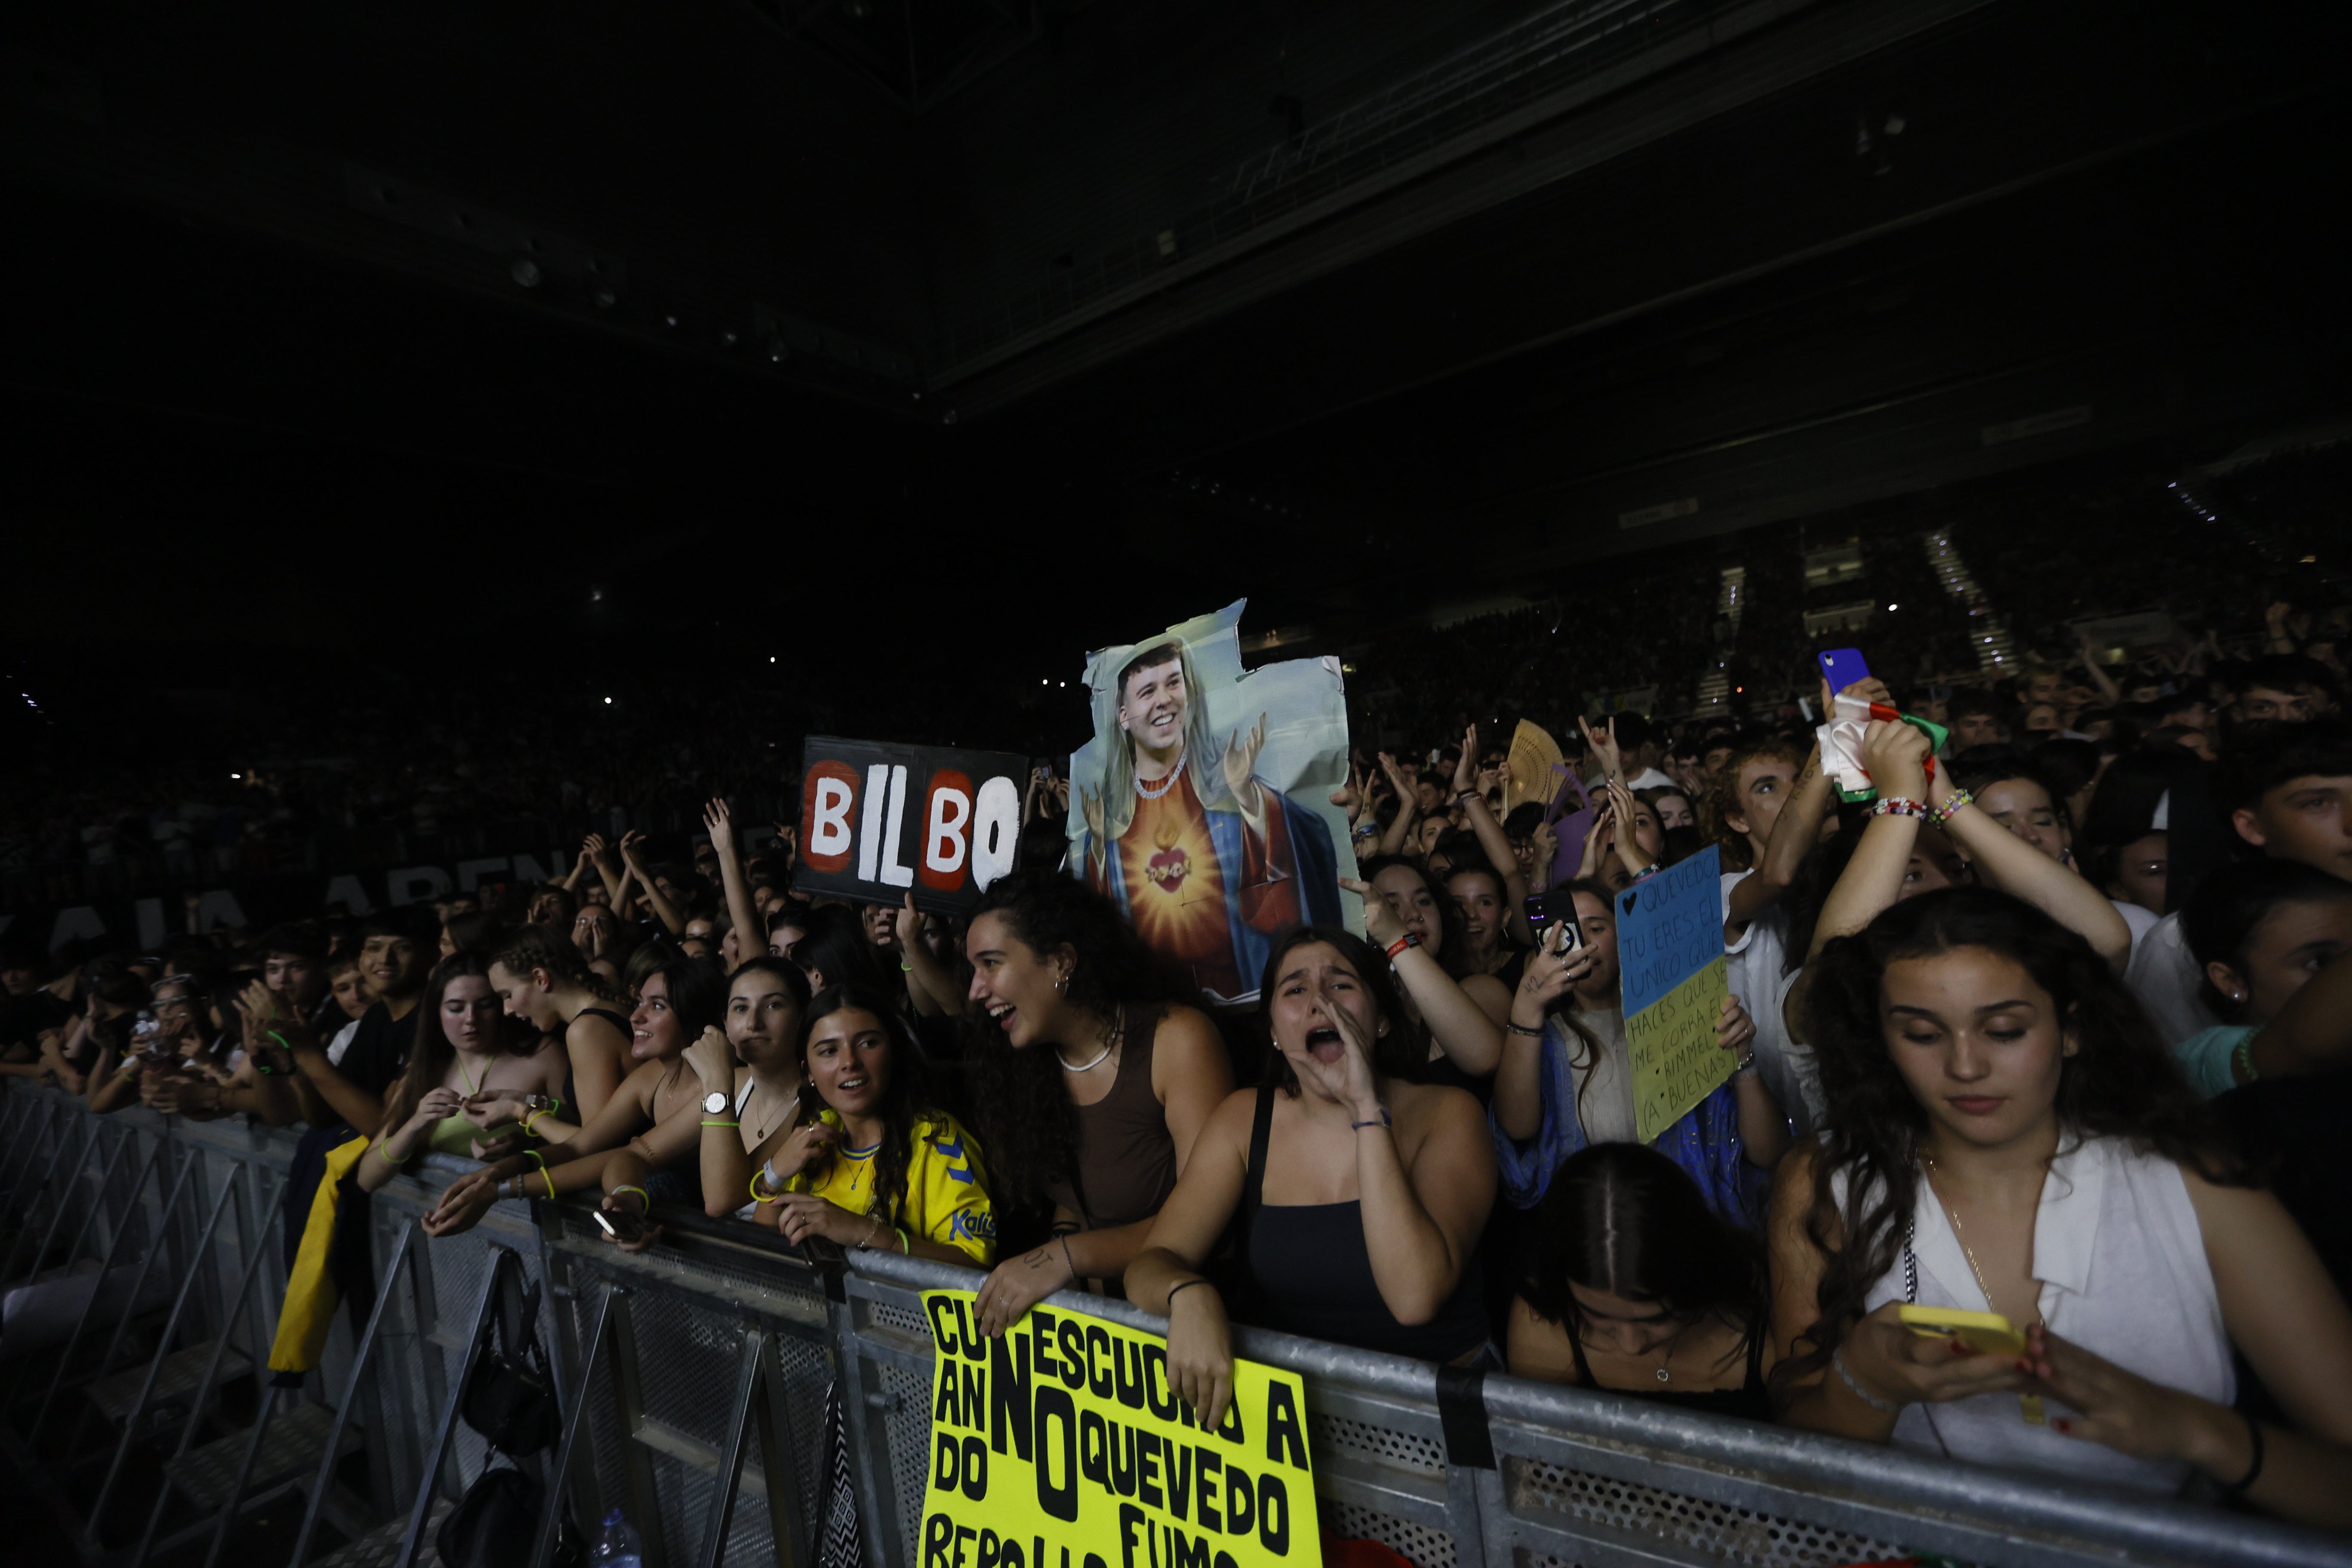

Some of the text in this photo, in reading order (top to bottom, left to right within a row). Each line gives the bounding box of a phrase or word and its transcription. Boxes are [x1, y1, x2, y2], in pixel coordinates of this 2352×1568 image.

[811, 763, 1020, 895] BILBO
[1642, 854, 1717, 913] QUEVEDO,
[1623, 894, 1720, 962] TU ERES EL
[1689, 930, 1717, 968] QUE
[1524, 975, 1544, 994] 42
[1630, 960, 1726, 1044] HACES QUE SE
[1635, 995, 1724, 1071] ME CORRA EL
[927, 1295, 986, 1361] CU
[935, 1359, 986, 1432] AN
[1266, 1379, 1309, 1472] A
[935, 1432, 988, 1501] DO
[1080, 1409, 1289, 1556] QUEVEDO
